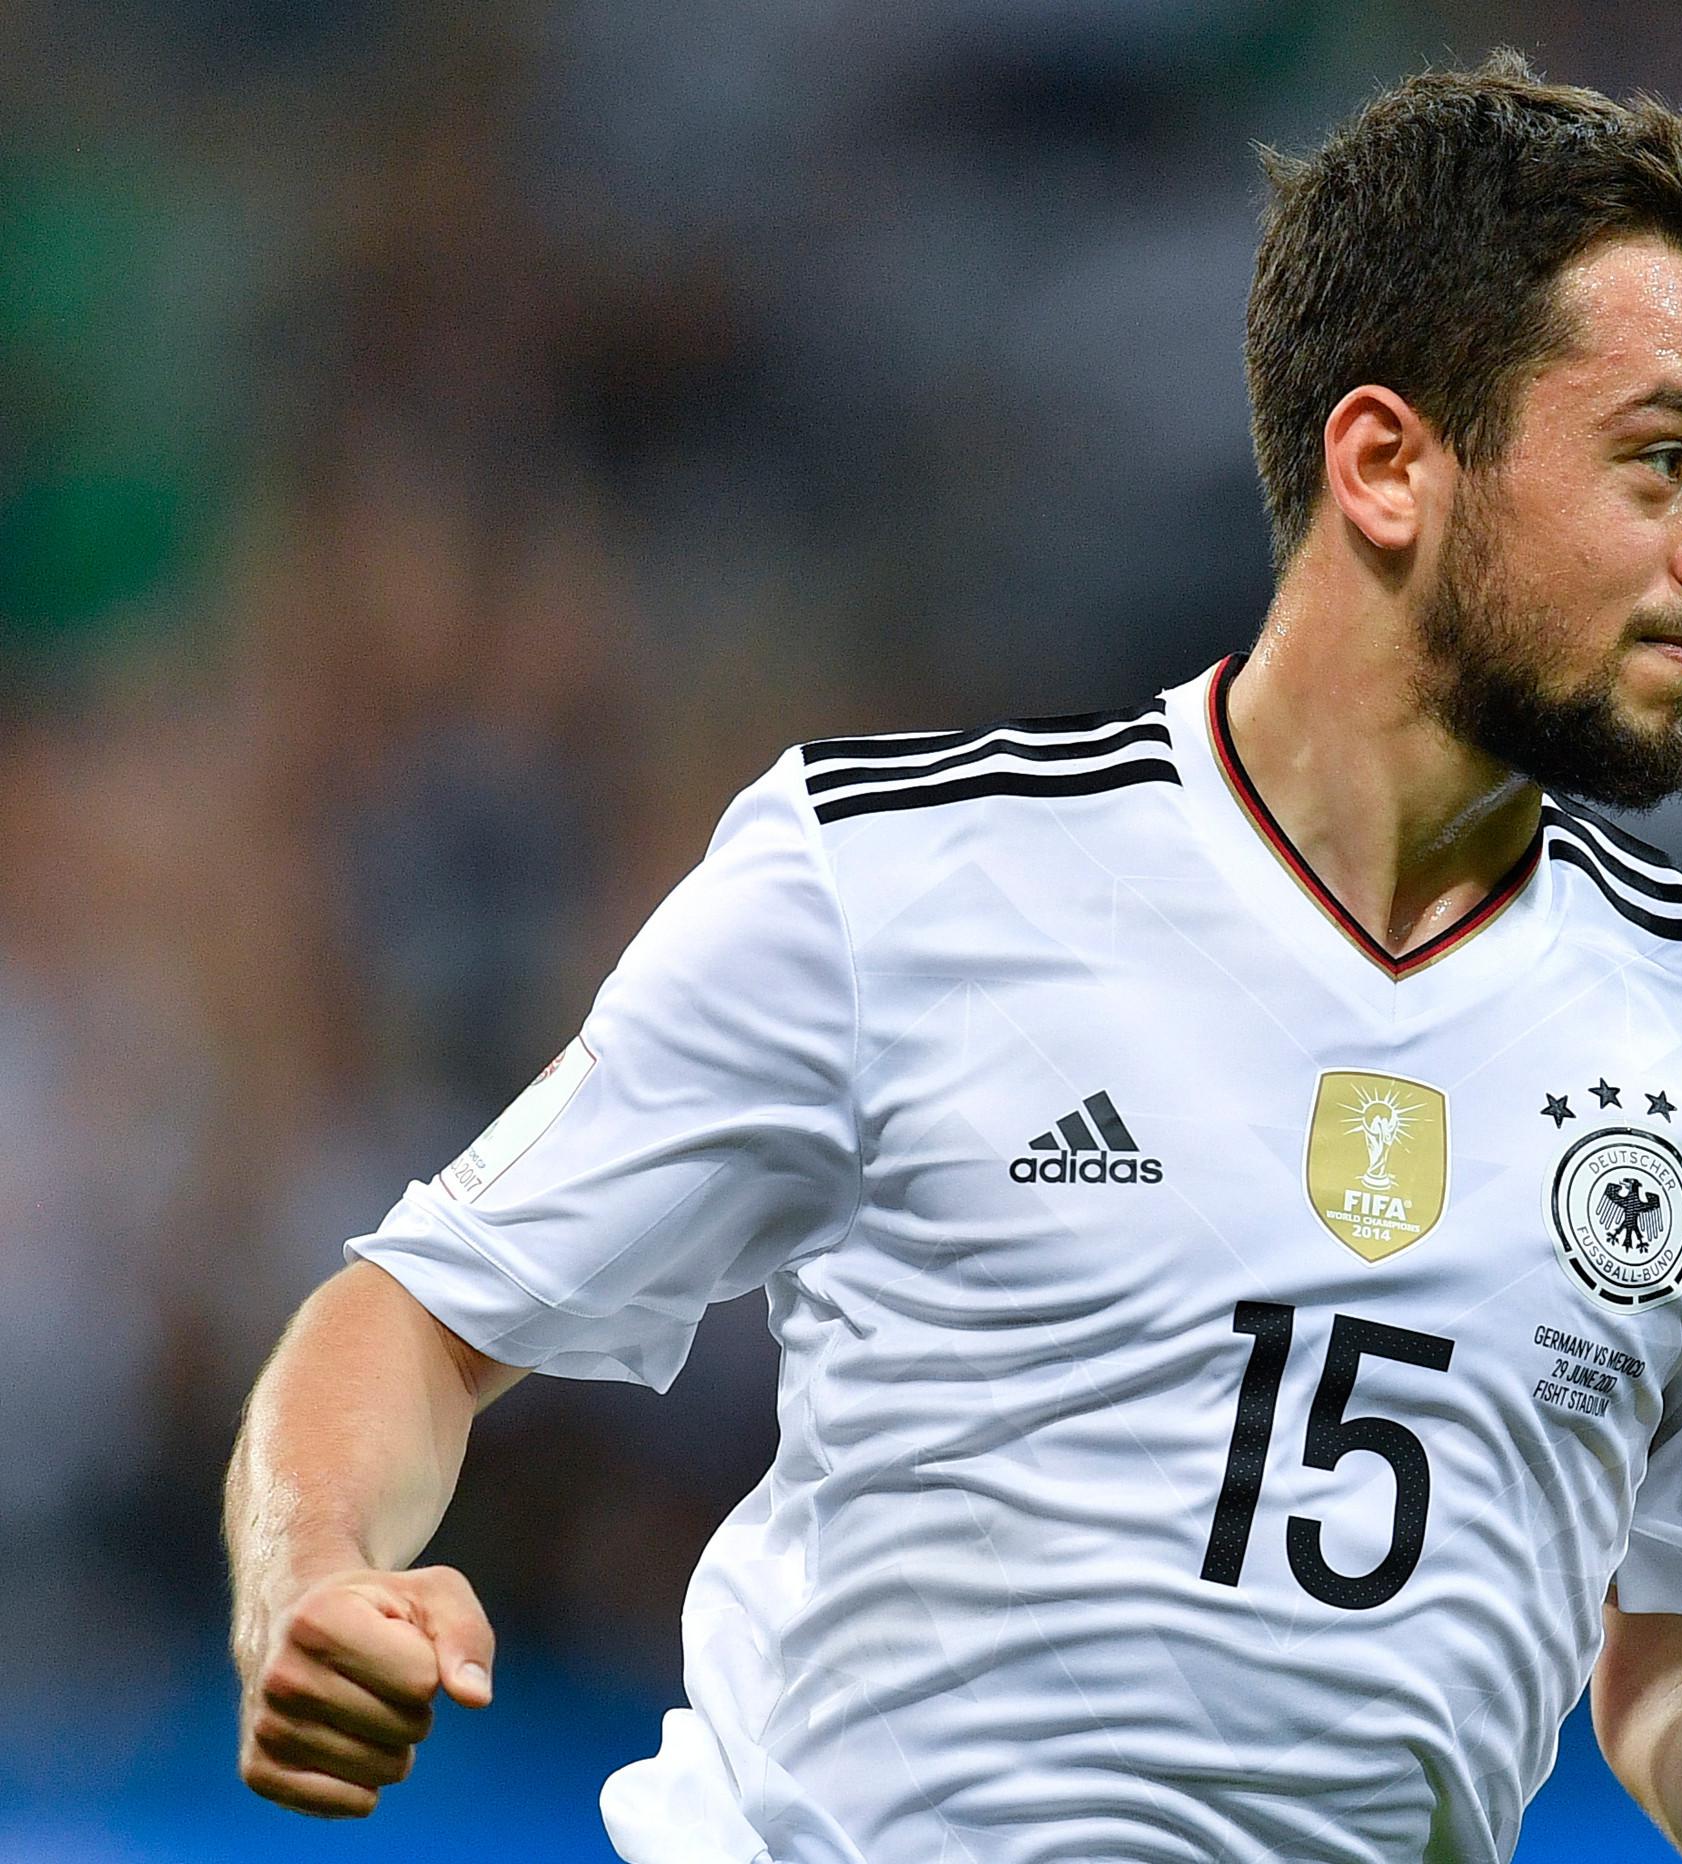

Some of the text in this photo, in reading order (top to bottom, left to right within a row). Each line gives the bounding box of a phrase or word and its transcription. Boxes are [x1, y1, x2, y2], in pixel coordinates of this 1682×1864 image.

[1009, 1149, 1164, 1184] adidas
[1588, 1150, 1676, 1191] DEUTSCHER
[1326, 1210, 1361, 1223] WORLD
[1343, 1189, 1407, 1221] FIFA
[1351, 1224, 1392, 1241] 2014
[1576, 1225, 1674, 1283] FUSSBALL-BUND
[1534, 1325, 1646, 1379] GERMANY VS MEXICO
[1551, 1358, 1569, 1379] 29
[1566, 1364, 1599, 1389] JUNE
[1532, 1379, 1570, 1406] FISHT
[1200, 1299, 1456, 1611] 15
